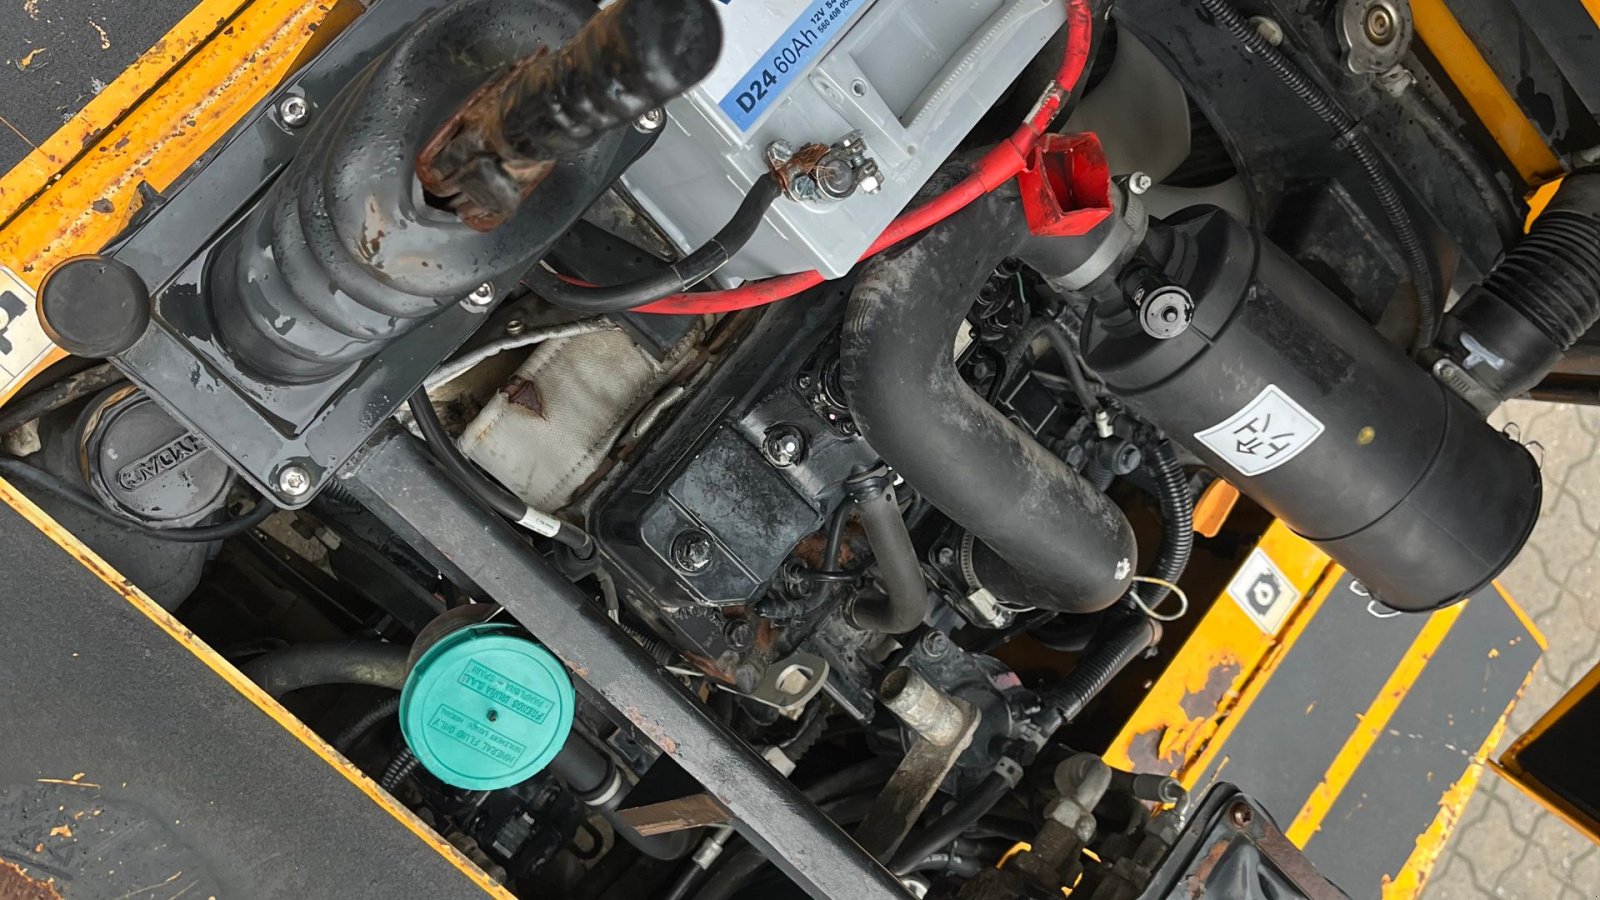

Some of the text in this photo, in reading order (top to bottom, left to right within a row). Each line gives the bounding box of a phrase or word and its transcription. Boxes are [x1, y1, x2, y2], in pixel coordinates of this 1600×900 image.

[811, 8, 825, 24] 12V
[817, 0, 853, 33] 560 408 05
[736, 29, 818, 114] D24 60Ah
[471, 666, 496, 682] SPAIN
[433, 718, 515, 763] MINERAL FLUID ONLY
